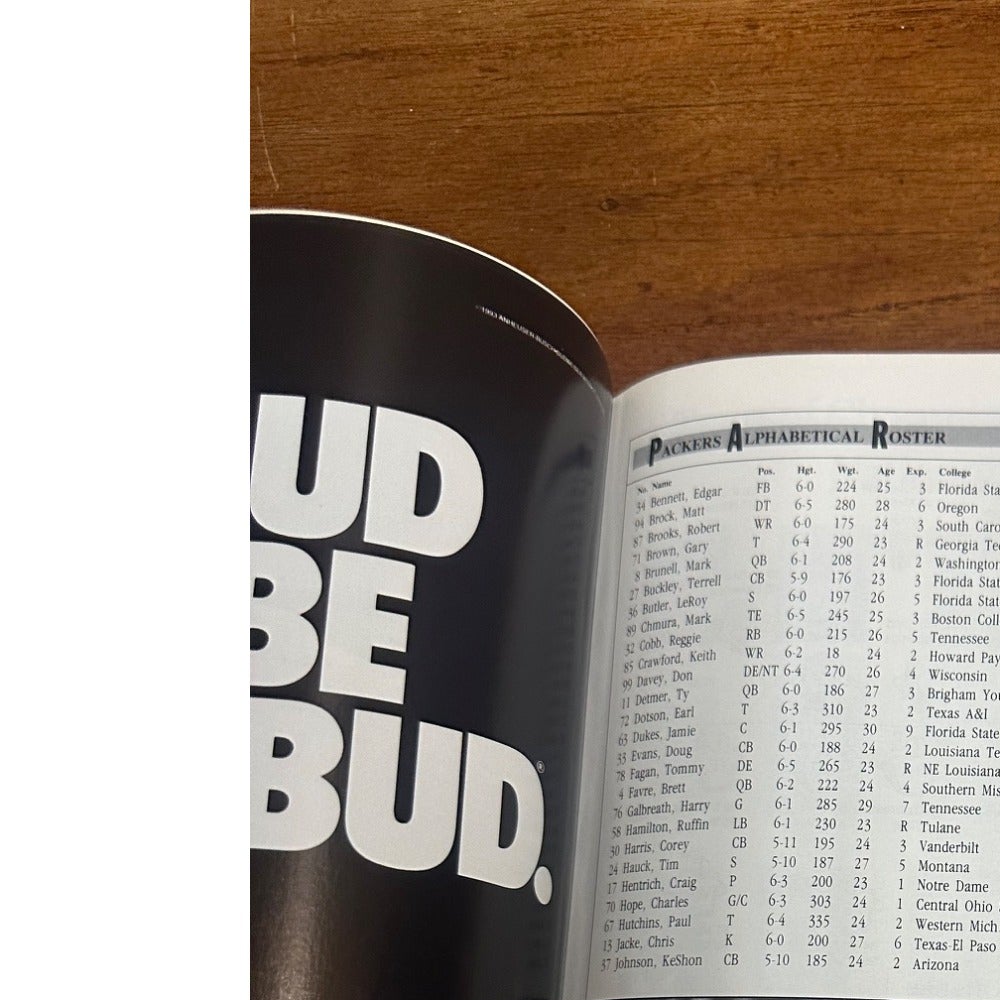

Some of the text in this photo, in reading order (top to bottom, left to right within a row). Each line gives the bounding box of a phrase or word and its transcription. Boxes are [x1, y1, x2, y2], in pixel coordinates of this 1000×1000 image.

[726, 422, 864, 453] ALPHABETICAL
[871, 419, 947, 450] ROSTER
[651, 481, 672, 489] Name
[758, 467, 775, 476] Pos.
[798, 466, 816, 475] Hgt.
[838, 466, 858, 476] Wgt.
[880, 467, 895, 476] Age
[907, 467, 926, 477] Exp.
[939, 468, 971, 478] College
[650, 492, 688, 508] Bennett,
[692, 487, 723, 500] Edgar
[756, 482, 770, 493] FB
[795, 481, 814, 492] 6-0
[835, 480, 856, 492] 224
[876, 481, 890, 493] 25
[938, 483, 977, 495] Florida
[250, 540, 416, 704] BE
[635, 675, 667, 688] Davey,
[671, 670, 693, 682] Don
[743, 665, 779, 677] DE/NT
[782, 663, 801, 677] 6-4
[824, 665, 846, 677] 270
[866, 666, 880, 678] 26
[928, 669, 987, 682] Wisconsin
[620, 877, 664, 892] Hentrich,
[668, 876, 697, 891] Craig
[769, 873, 787, 888] 6-3
[810, 875, 833, 888] 200
[853, 876, 867, 890] 23
[916, 879, 949, 892] Notre
[955, 880, 989, 892] Dame
